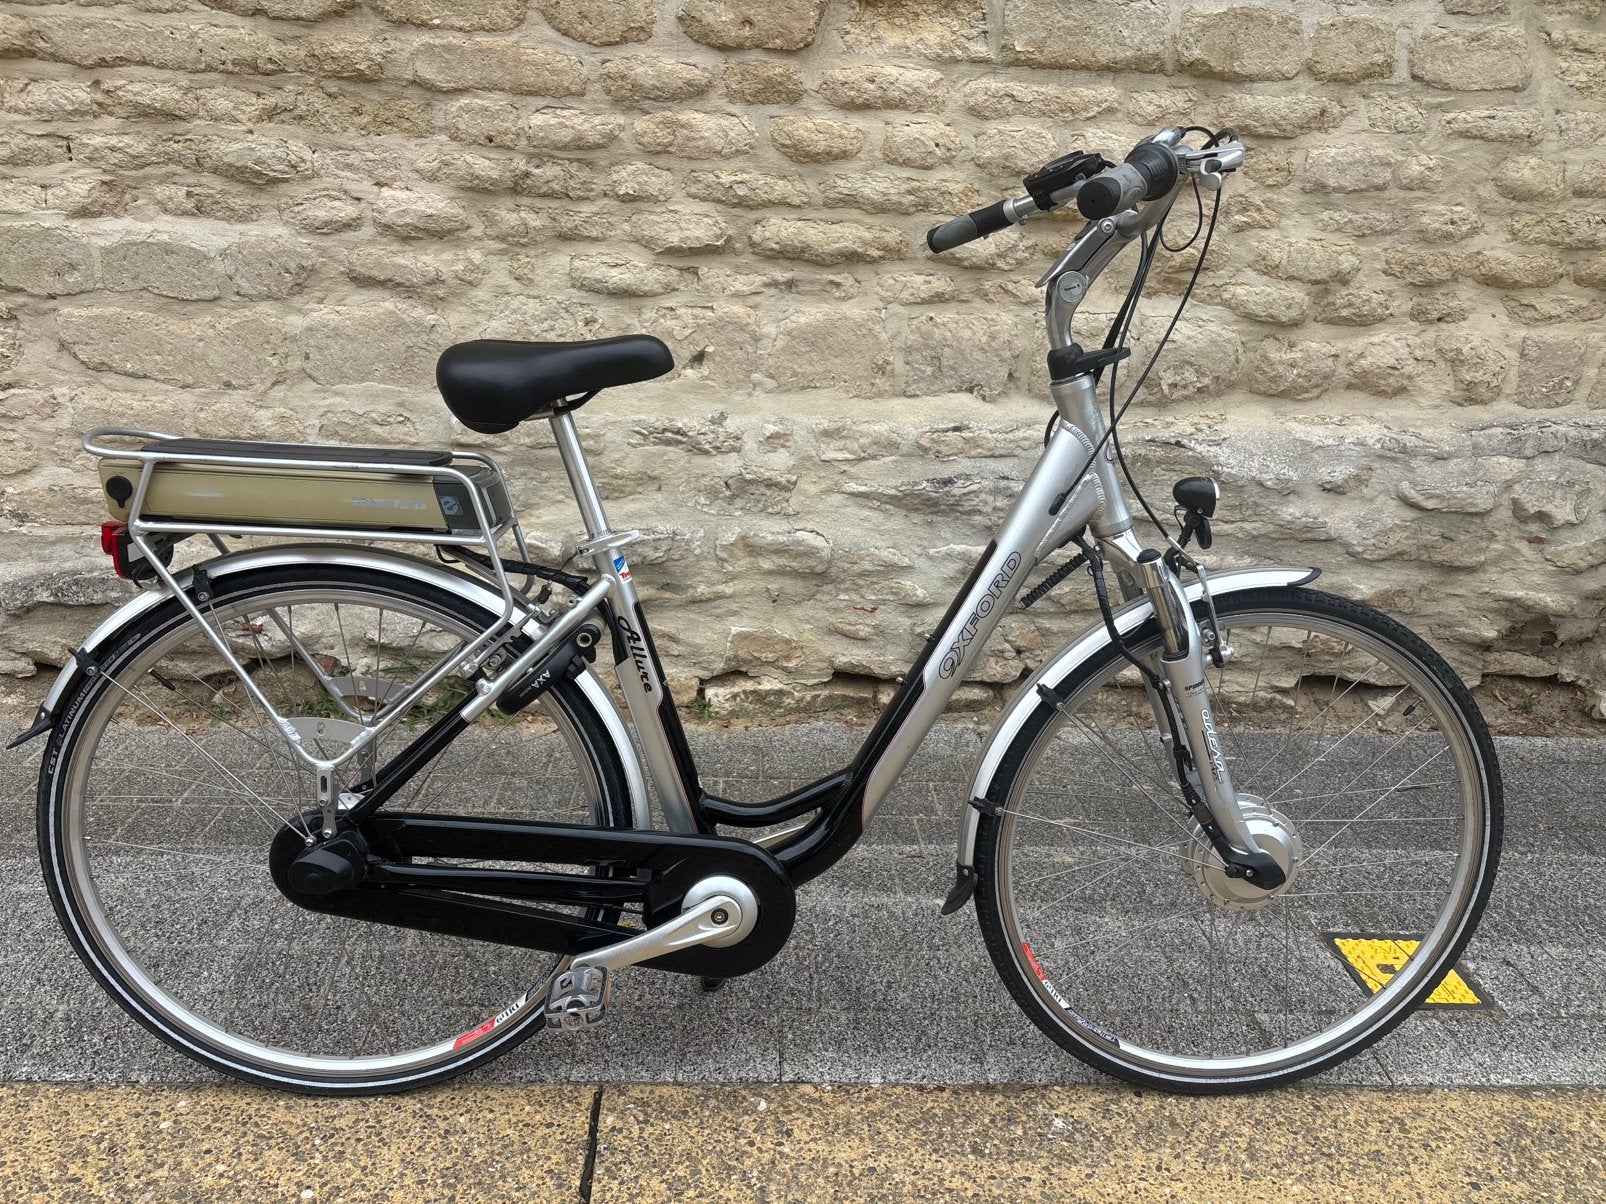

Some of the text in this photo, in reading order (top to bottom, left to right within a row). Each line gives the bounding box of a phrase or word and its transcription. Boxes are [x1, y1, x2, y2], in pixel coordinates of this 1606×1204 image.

[938, 551, 1021, 680] OXFORD
[531, 669, 550, 688] AXA
[617, 615, 653, 693] Allure
[47, 750, 59, 775] CST
